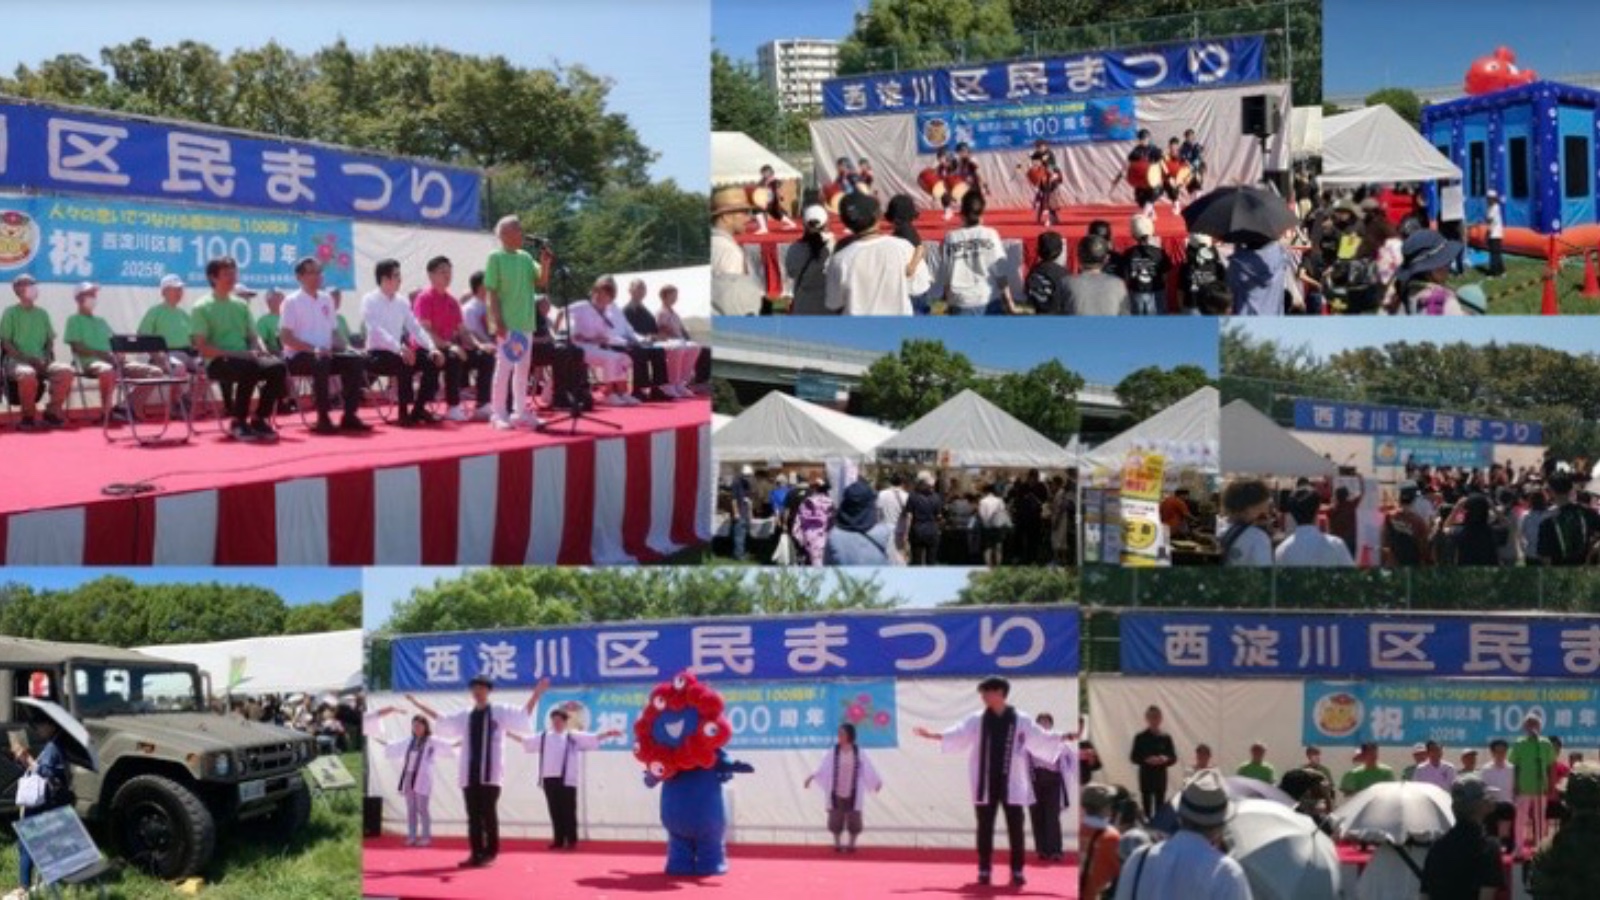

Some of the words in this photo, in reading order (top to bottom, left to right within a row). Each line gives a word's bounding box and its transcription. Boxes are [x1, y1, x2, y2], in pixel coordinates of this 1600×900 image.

[843, 43, 1231, 110] 西淀川区民まつり
[50, 229, 93, 277] 祝
[1314, 405, 1530, 441] 西淀川区民まつり
[423, 616, 1046, 682] 西淀川区民まつり
[1163, 623, 1600, 671] 西淀川区民ま
[1370, 706, 1404, 740] 祝
